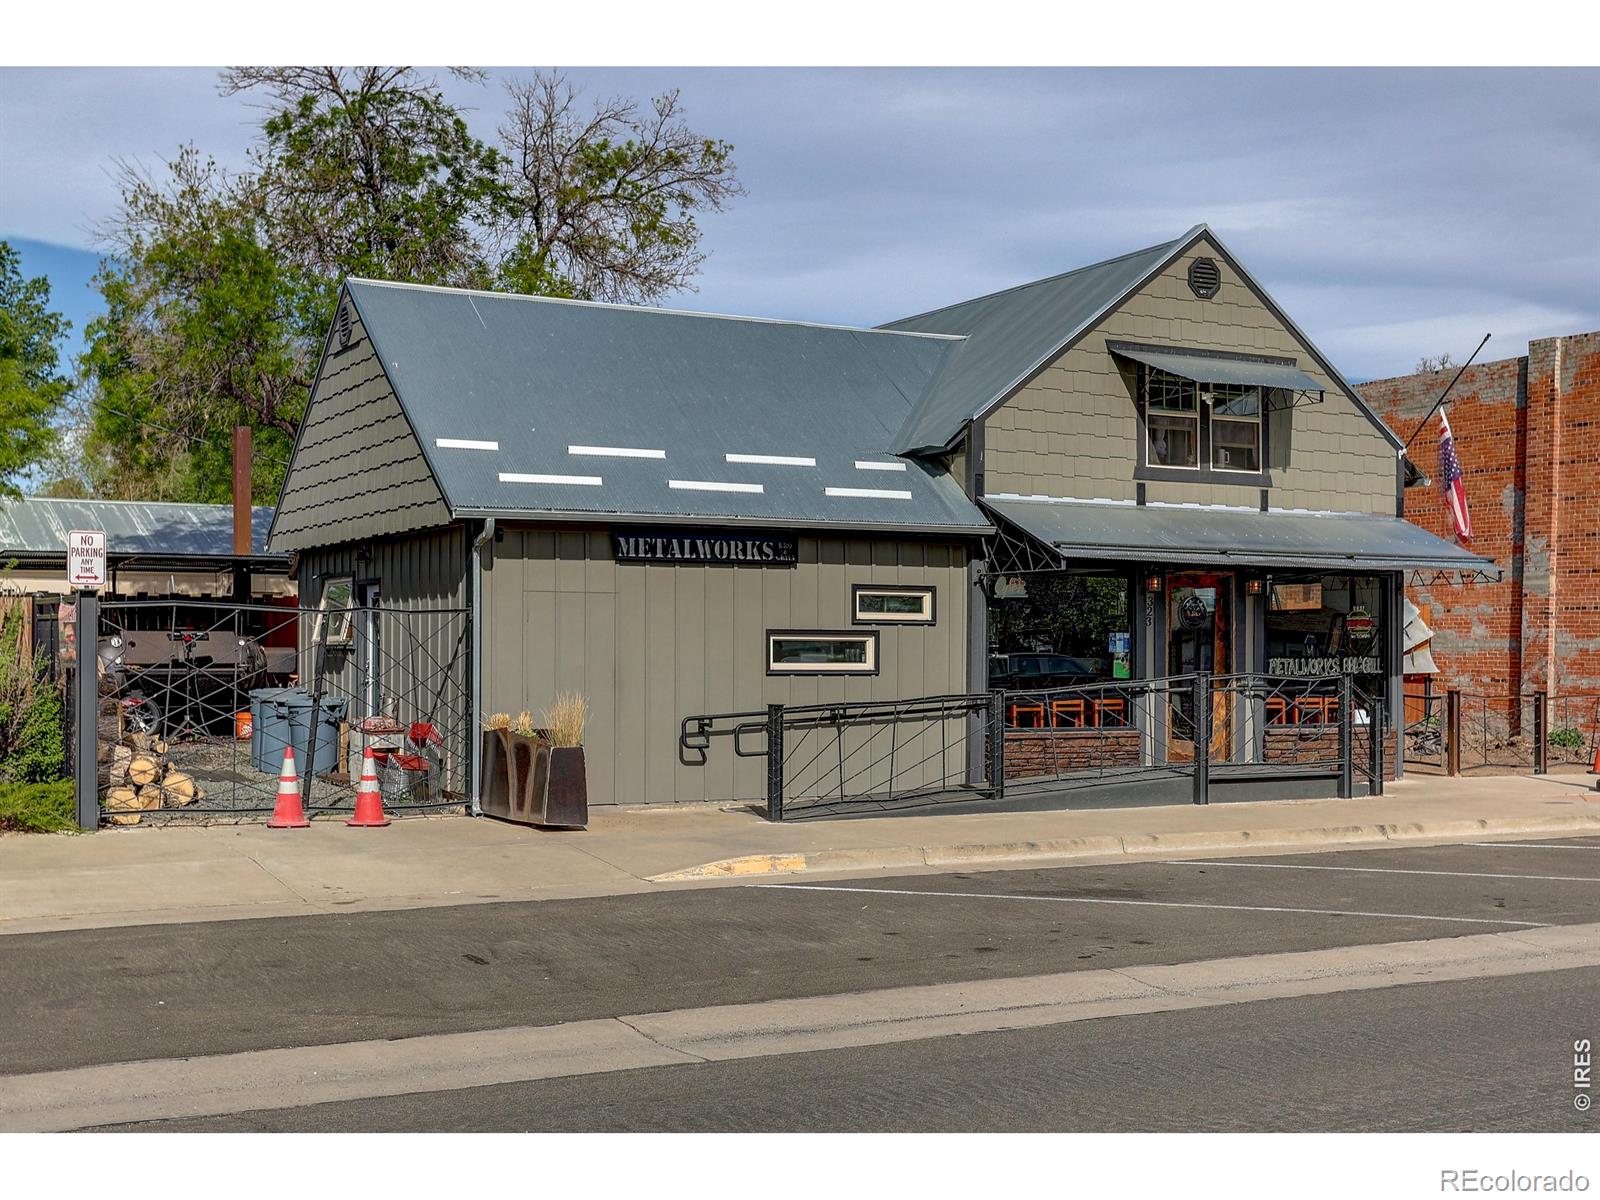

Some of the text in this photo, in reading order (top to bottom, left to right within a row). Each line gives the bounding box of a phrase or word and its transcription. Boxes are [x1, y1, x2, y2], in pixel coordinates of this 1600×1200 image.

[80, 535, 94, 546] NO
[71, 547, 103, 558] PARKING
[617, 537, 774, 561] METALWORKS
[80, 558, 94, 566] ANY
[80, 566, 95, 574] TIME
[1145, 596, 1154, 627] 323
[1268, 657, 1340, 676] METALWORKS
